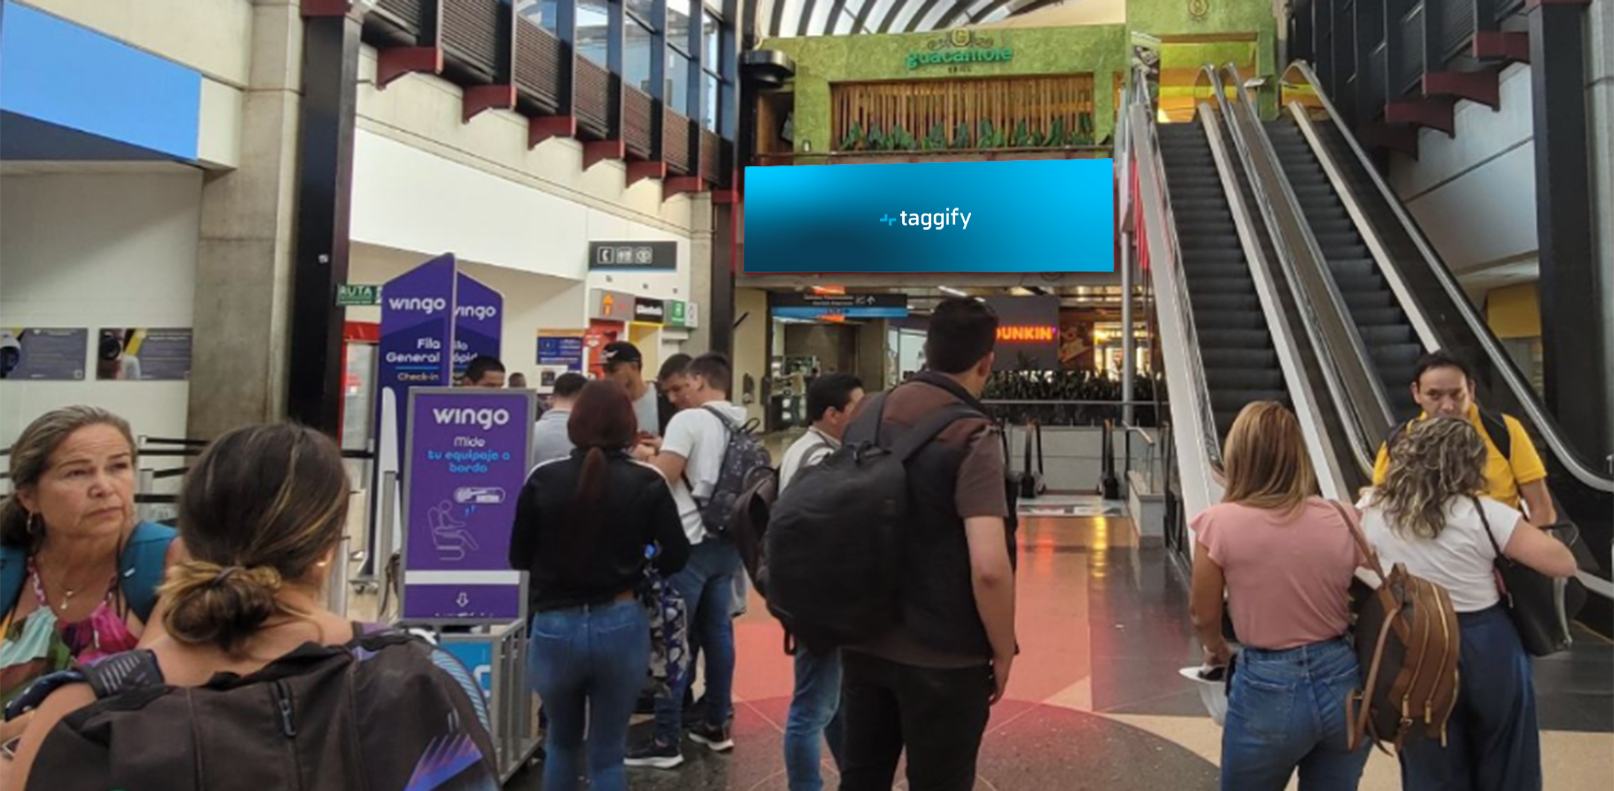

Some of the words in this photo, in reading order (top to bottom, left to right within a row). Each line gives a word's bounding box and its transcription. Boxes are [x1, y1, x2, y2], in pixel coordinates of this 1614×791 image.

[905, 47, 1013, 70] guacamole
[900, 207, 971, 230] taggify
[339, 286, 372, 298] RUTA
[389, 297, 446, 314] wingo
[417, 338, 441, 350] Fila
[386, 352, 440, 363] General
[397, 372, 439, 382] Check-in
[433, 408, 509, 430] wingo
[427, 450, 442, 460] tu
[445, 449, 499, 462] equipaje
[449, 462, 488, 473] bordo
